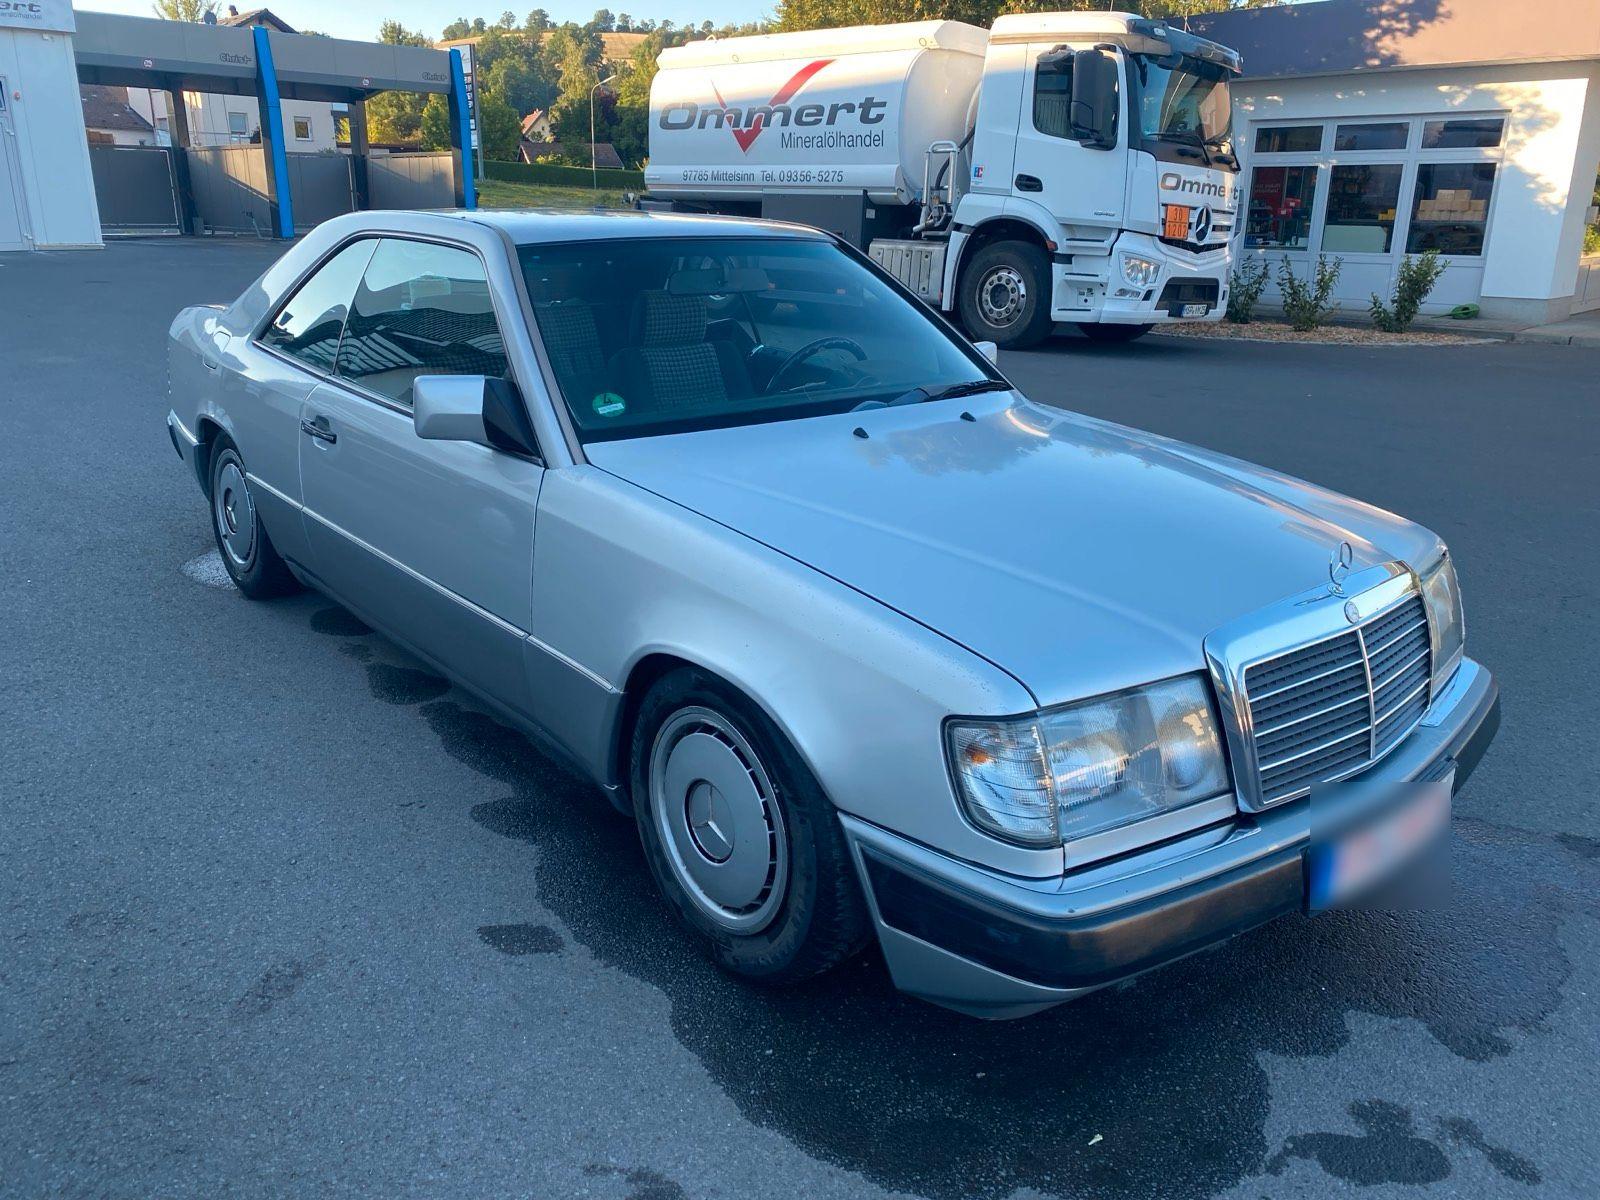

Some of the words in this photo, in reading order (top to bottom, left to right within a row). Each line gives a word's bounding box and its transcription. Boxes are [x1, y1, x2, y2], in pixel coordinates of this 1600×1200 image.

[659, 97, 887, 131] Ommert
[781, 130, 884, 150] Mineralölhandel
[711, 169, 755, 183] Mittelsinn
[761, 171, 776, 183] Tel.
[1160, 172, 1239, 201] Ommet
[1173, 207, 1183, 221] 30
